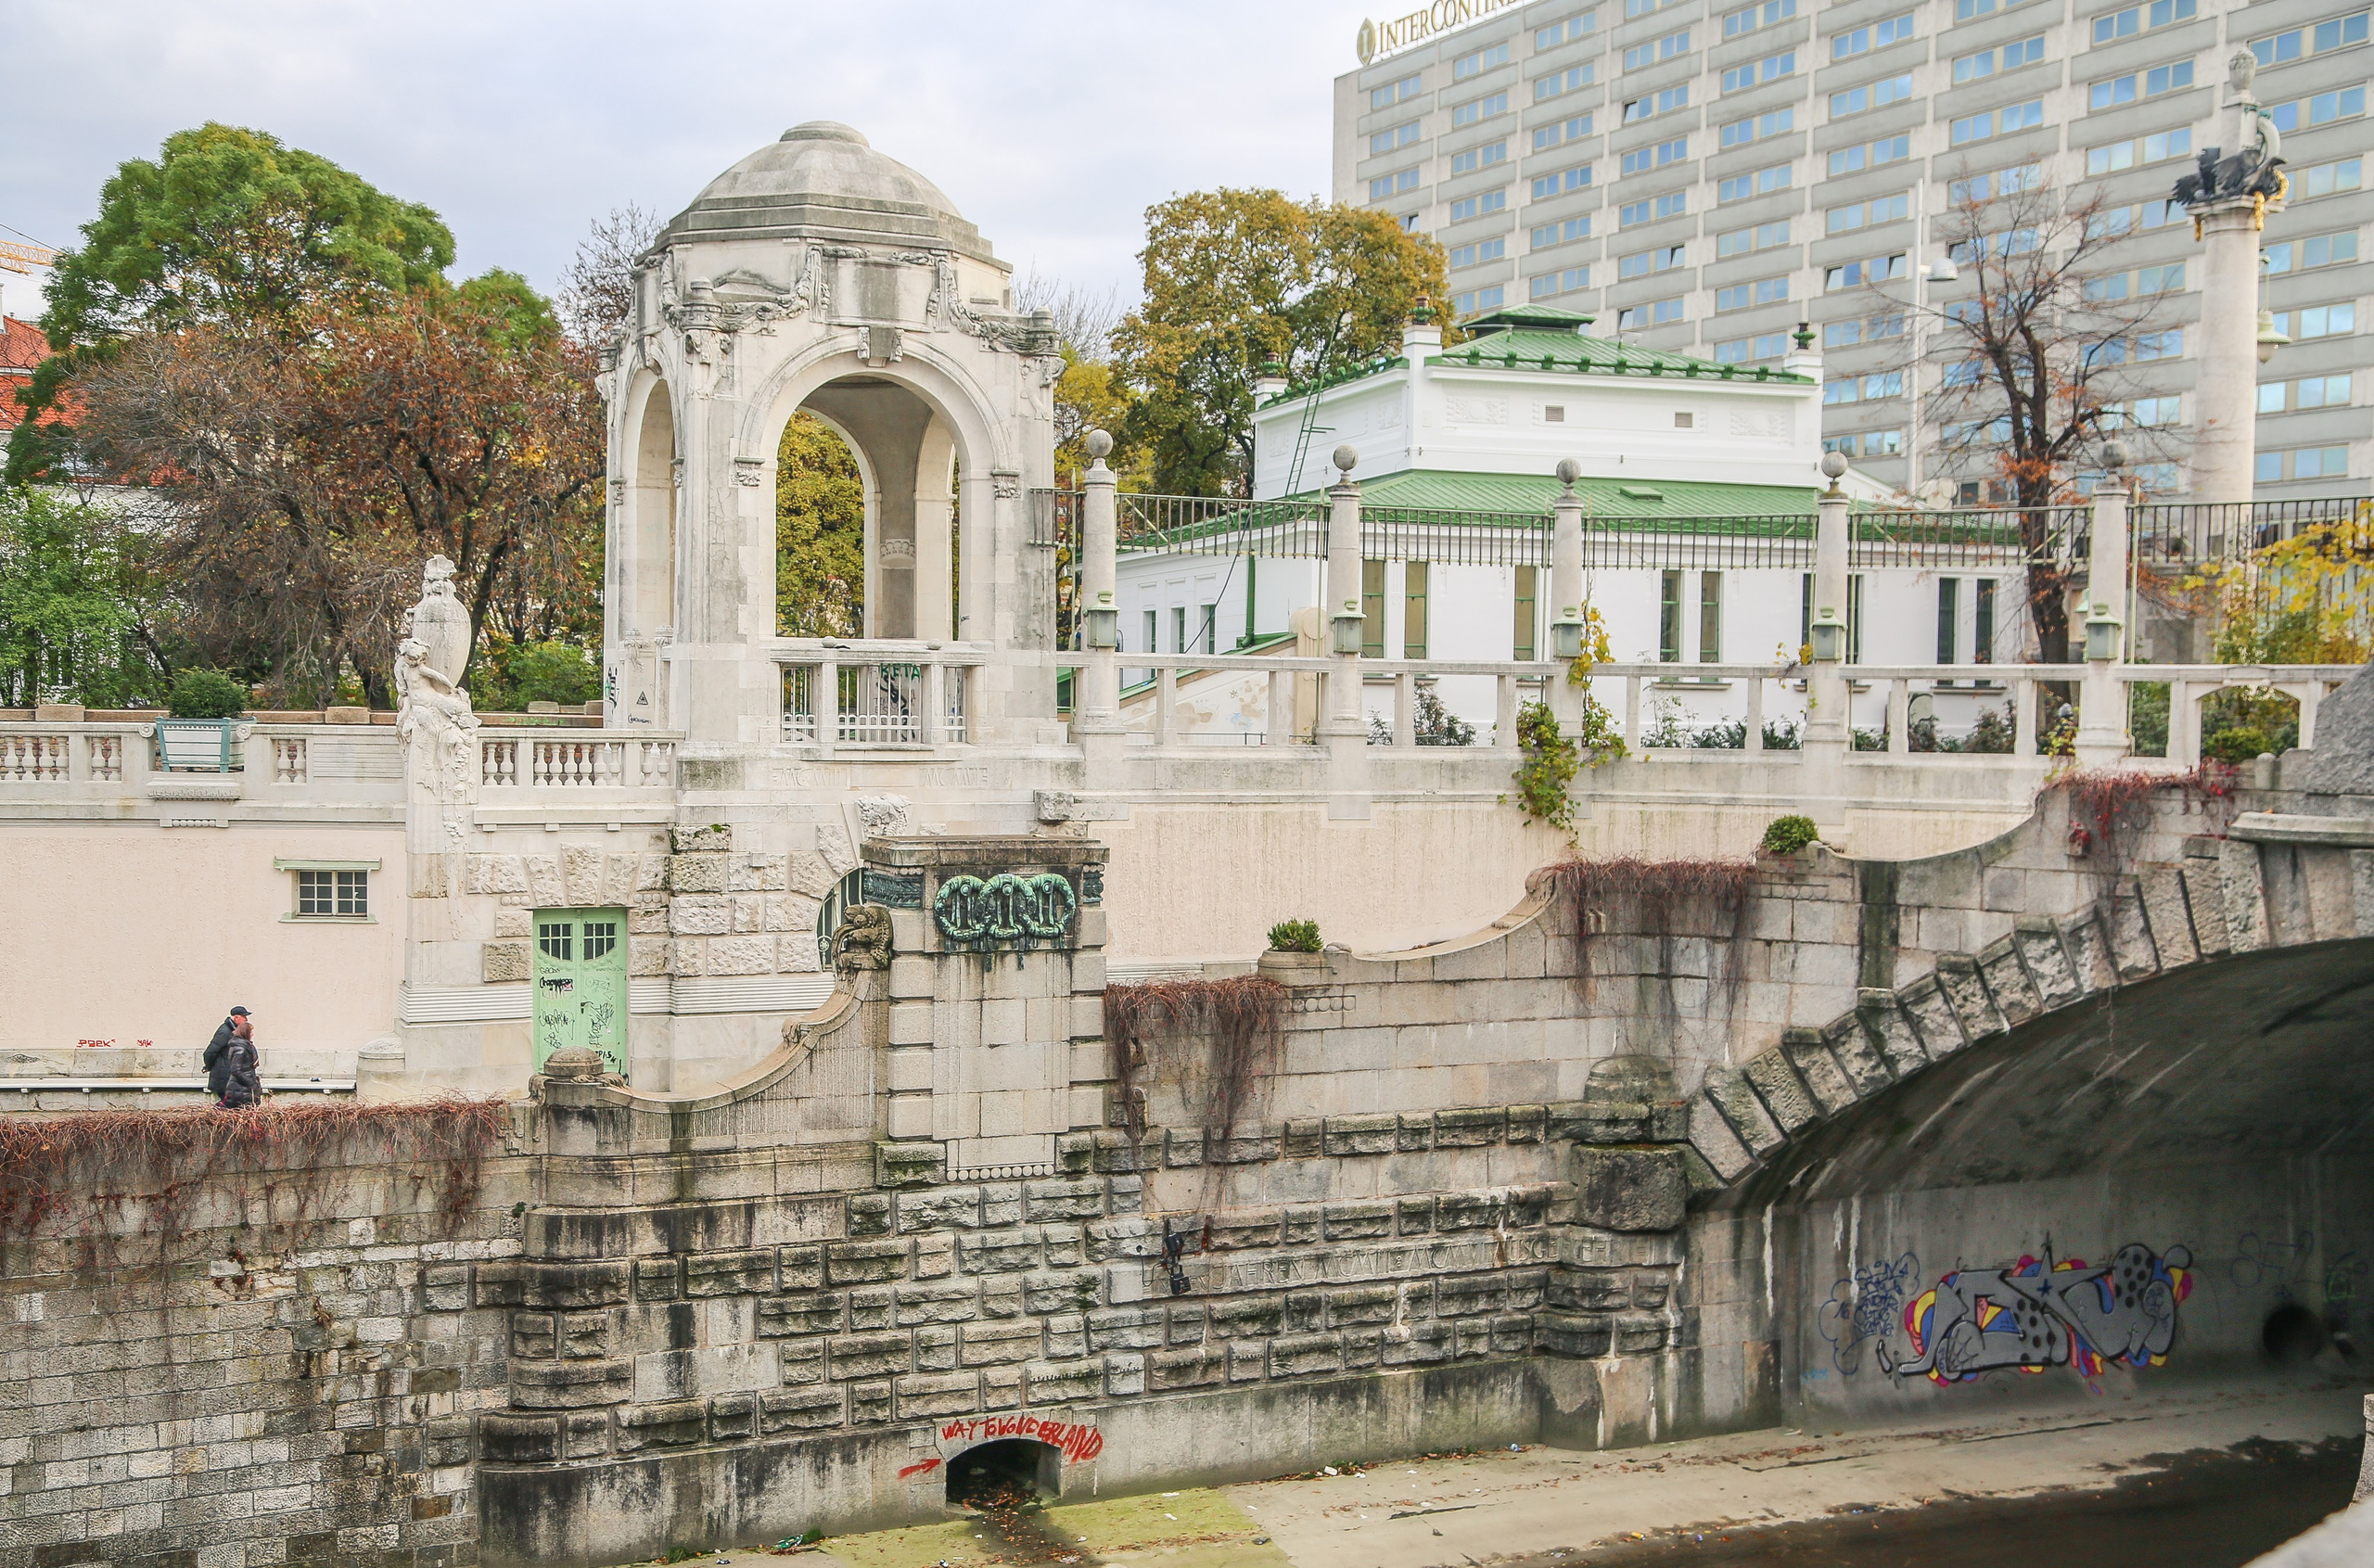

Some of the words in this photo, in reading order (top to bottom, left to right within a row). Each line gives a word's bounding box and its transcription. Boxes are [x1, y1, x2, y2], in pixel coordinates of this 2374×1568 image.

[1213, 1256, 1305, 1290] JAHREN
[941, 1419, 977, 1440] WAY
[979, 1417, 996, 1438] TO
[997, 1416, 1104, 1464] WONDERLAND
